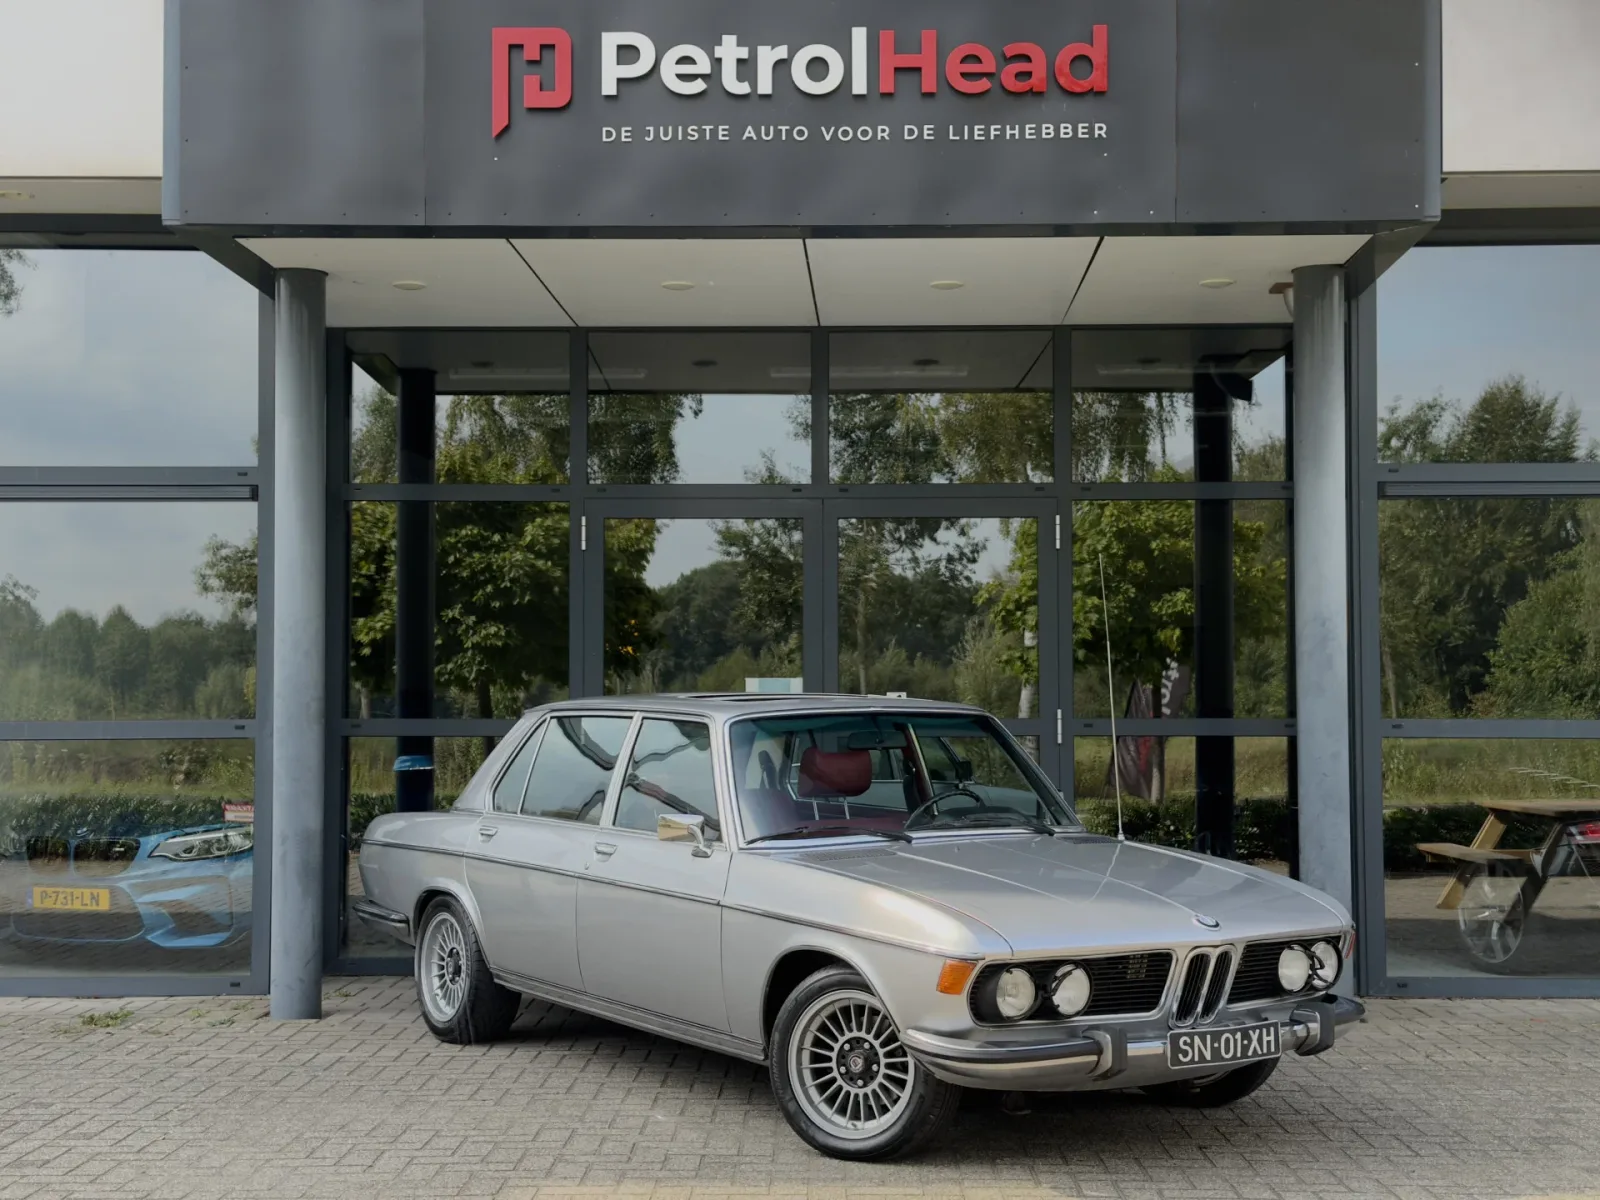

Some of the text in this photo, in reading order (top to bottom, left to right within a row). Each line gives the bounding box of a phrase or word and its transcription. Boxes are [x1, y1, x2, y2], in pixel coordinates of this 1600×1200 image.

[601, 25, 1108, 95] PetrolHead
[602, 122, 1108, 142] DE JUISTE AUTO VOOR DE LIEFHEBBER
[40, 889, 100, 907] P-731-LN
[1178, 1026, 1275, 1062] SN-01-XH
